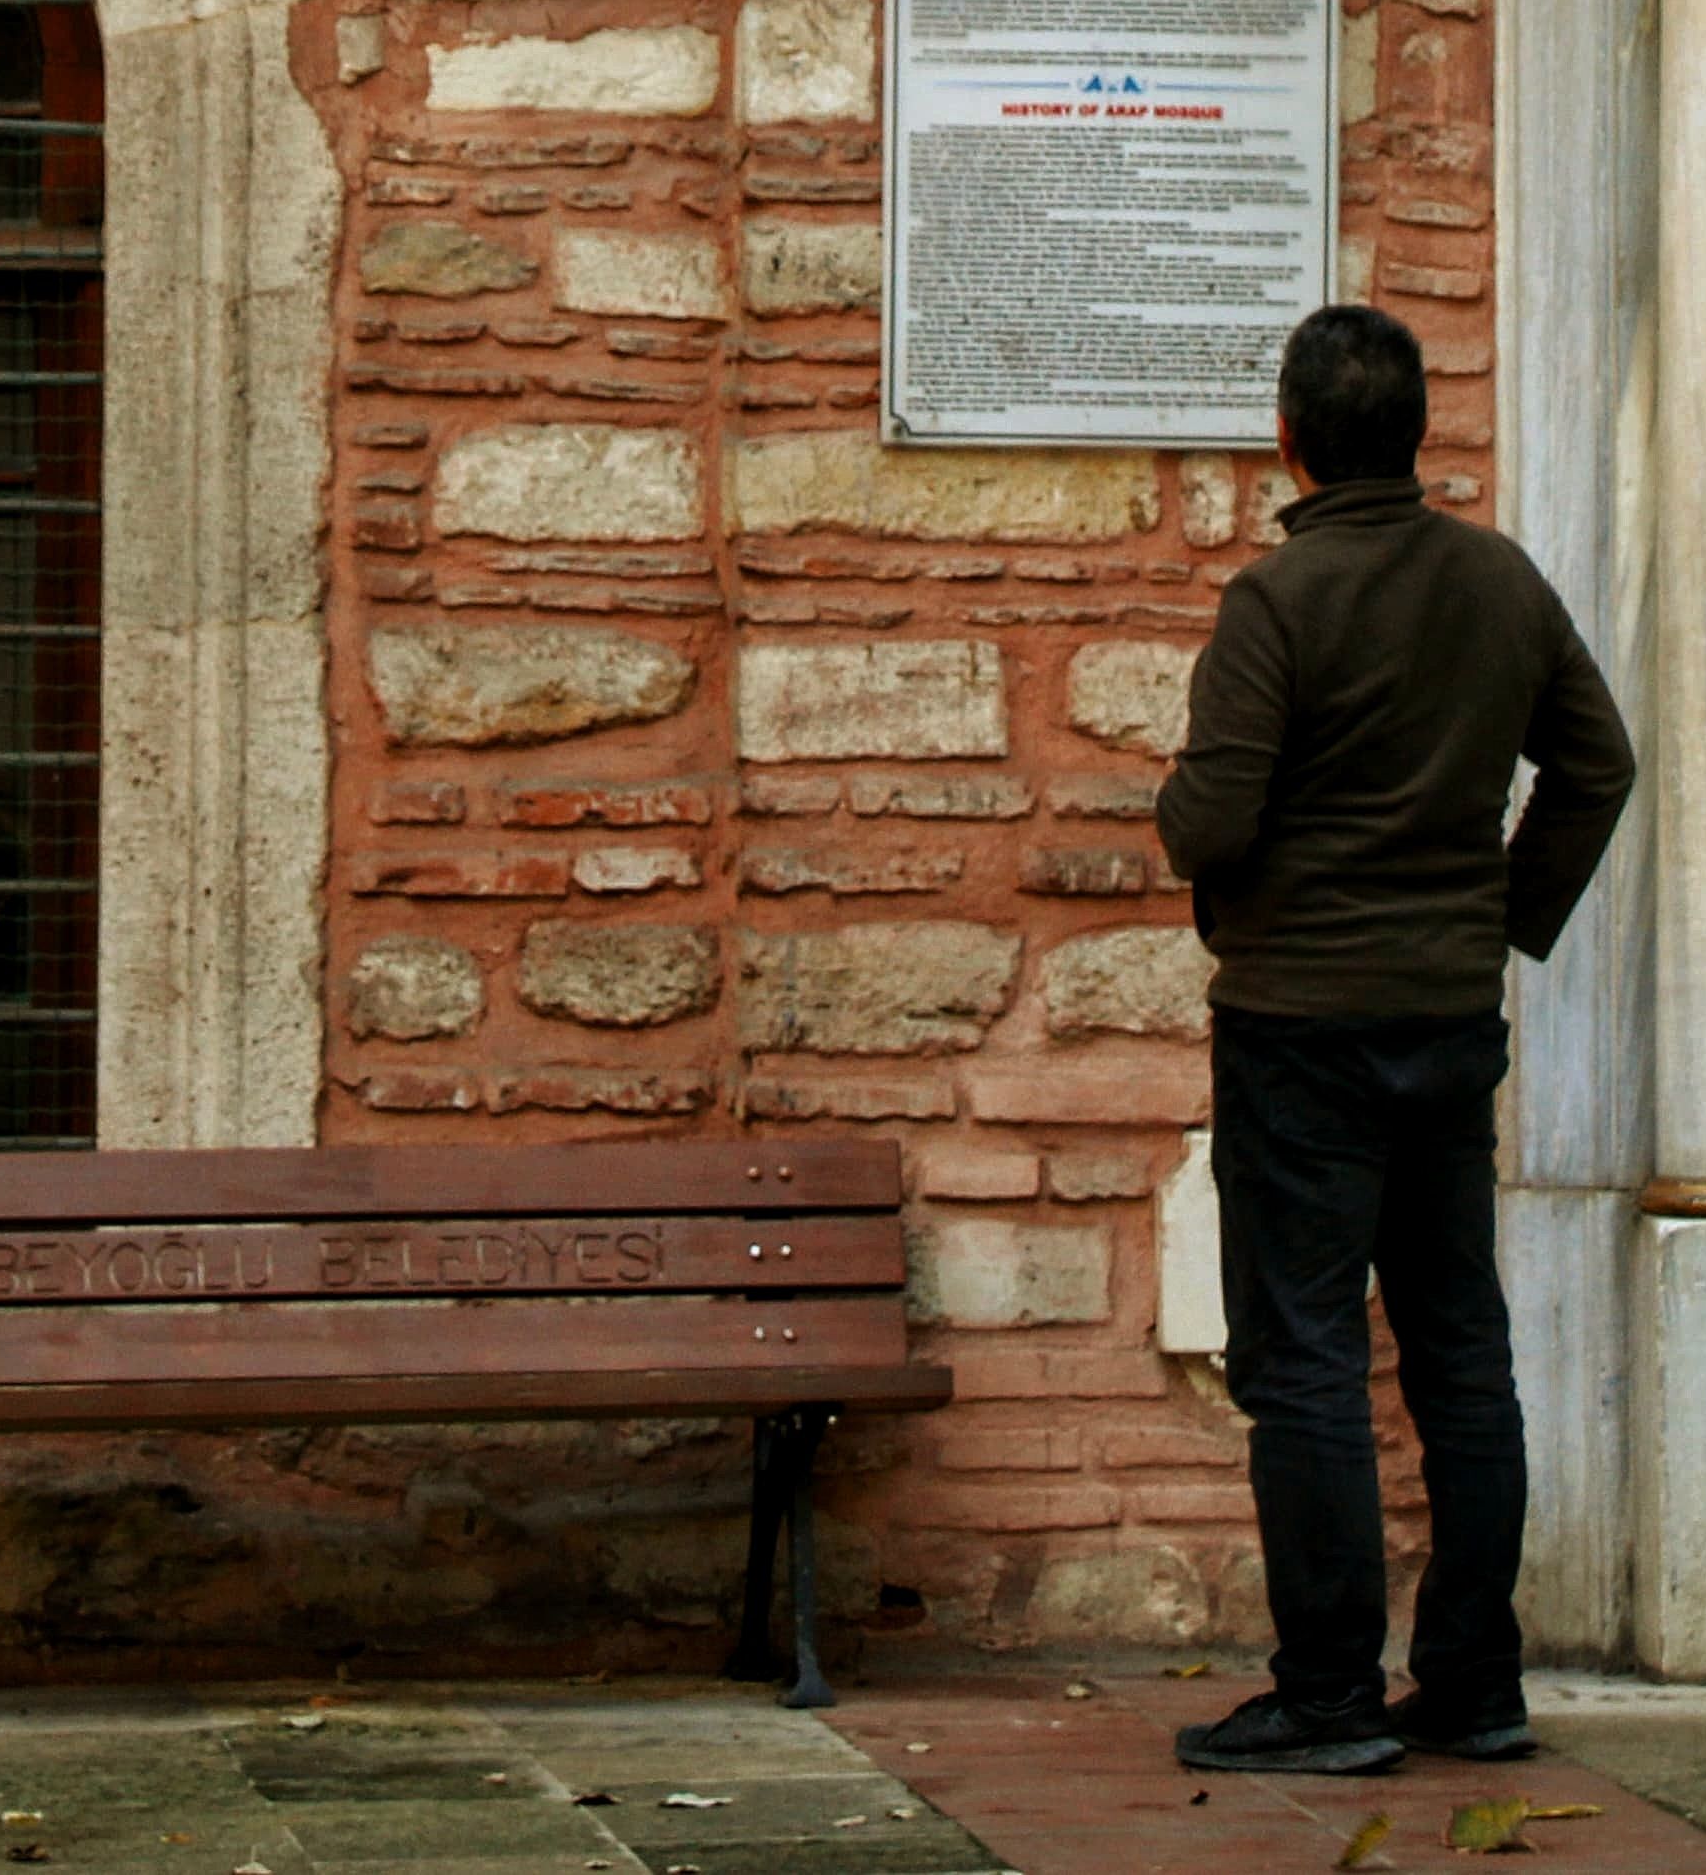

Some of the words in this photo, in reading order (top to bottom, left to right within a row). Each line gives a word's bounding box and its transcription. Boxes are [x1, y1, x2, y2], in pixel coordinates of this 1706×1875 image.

[1002, 102, 1071, 117] HISTORY
[1078, 103, 1099, 117] OF
[1105, 104, 1149, 119] ARAP
[1153, 105, 1224, 120] MOSQUE
[318, 1225, 666, 1287] BELEDİYESİ
